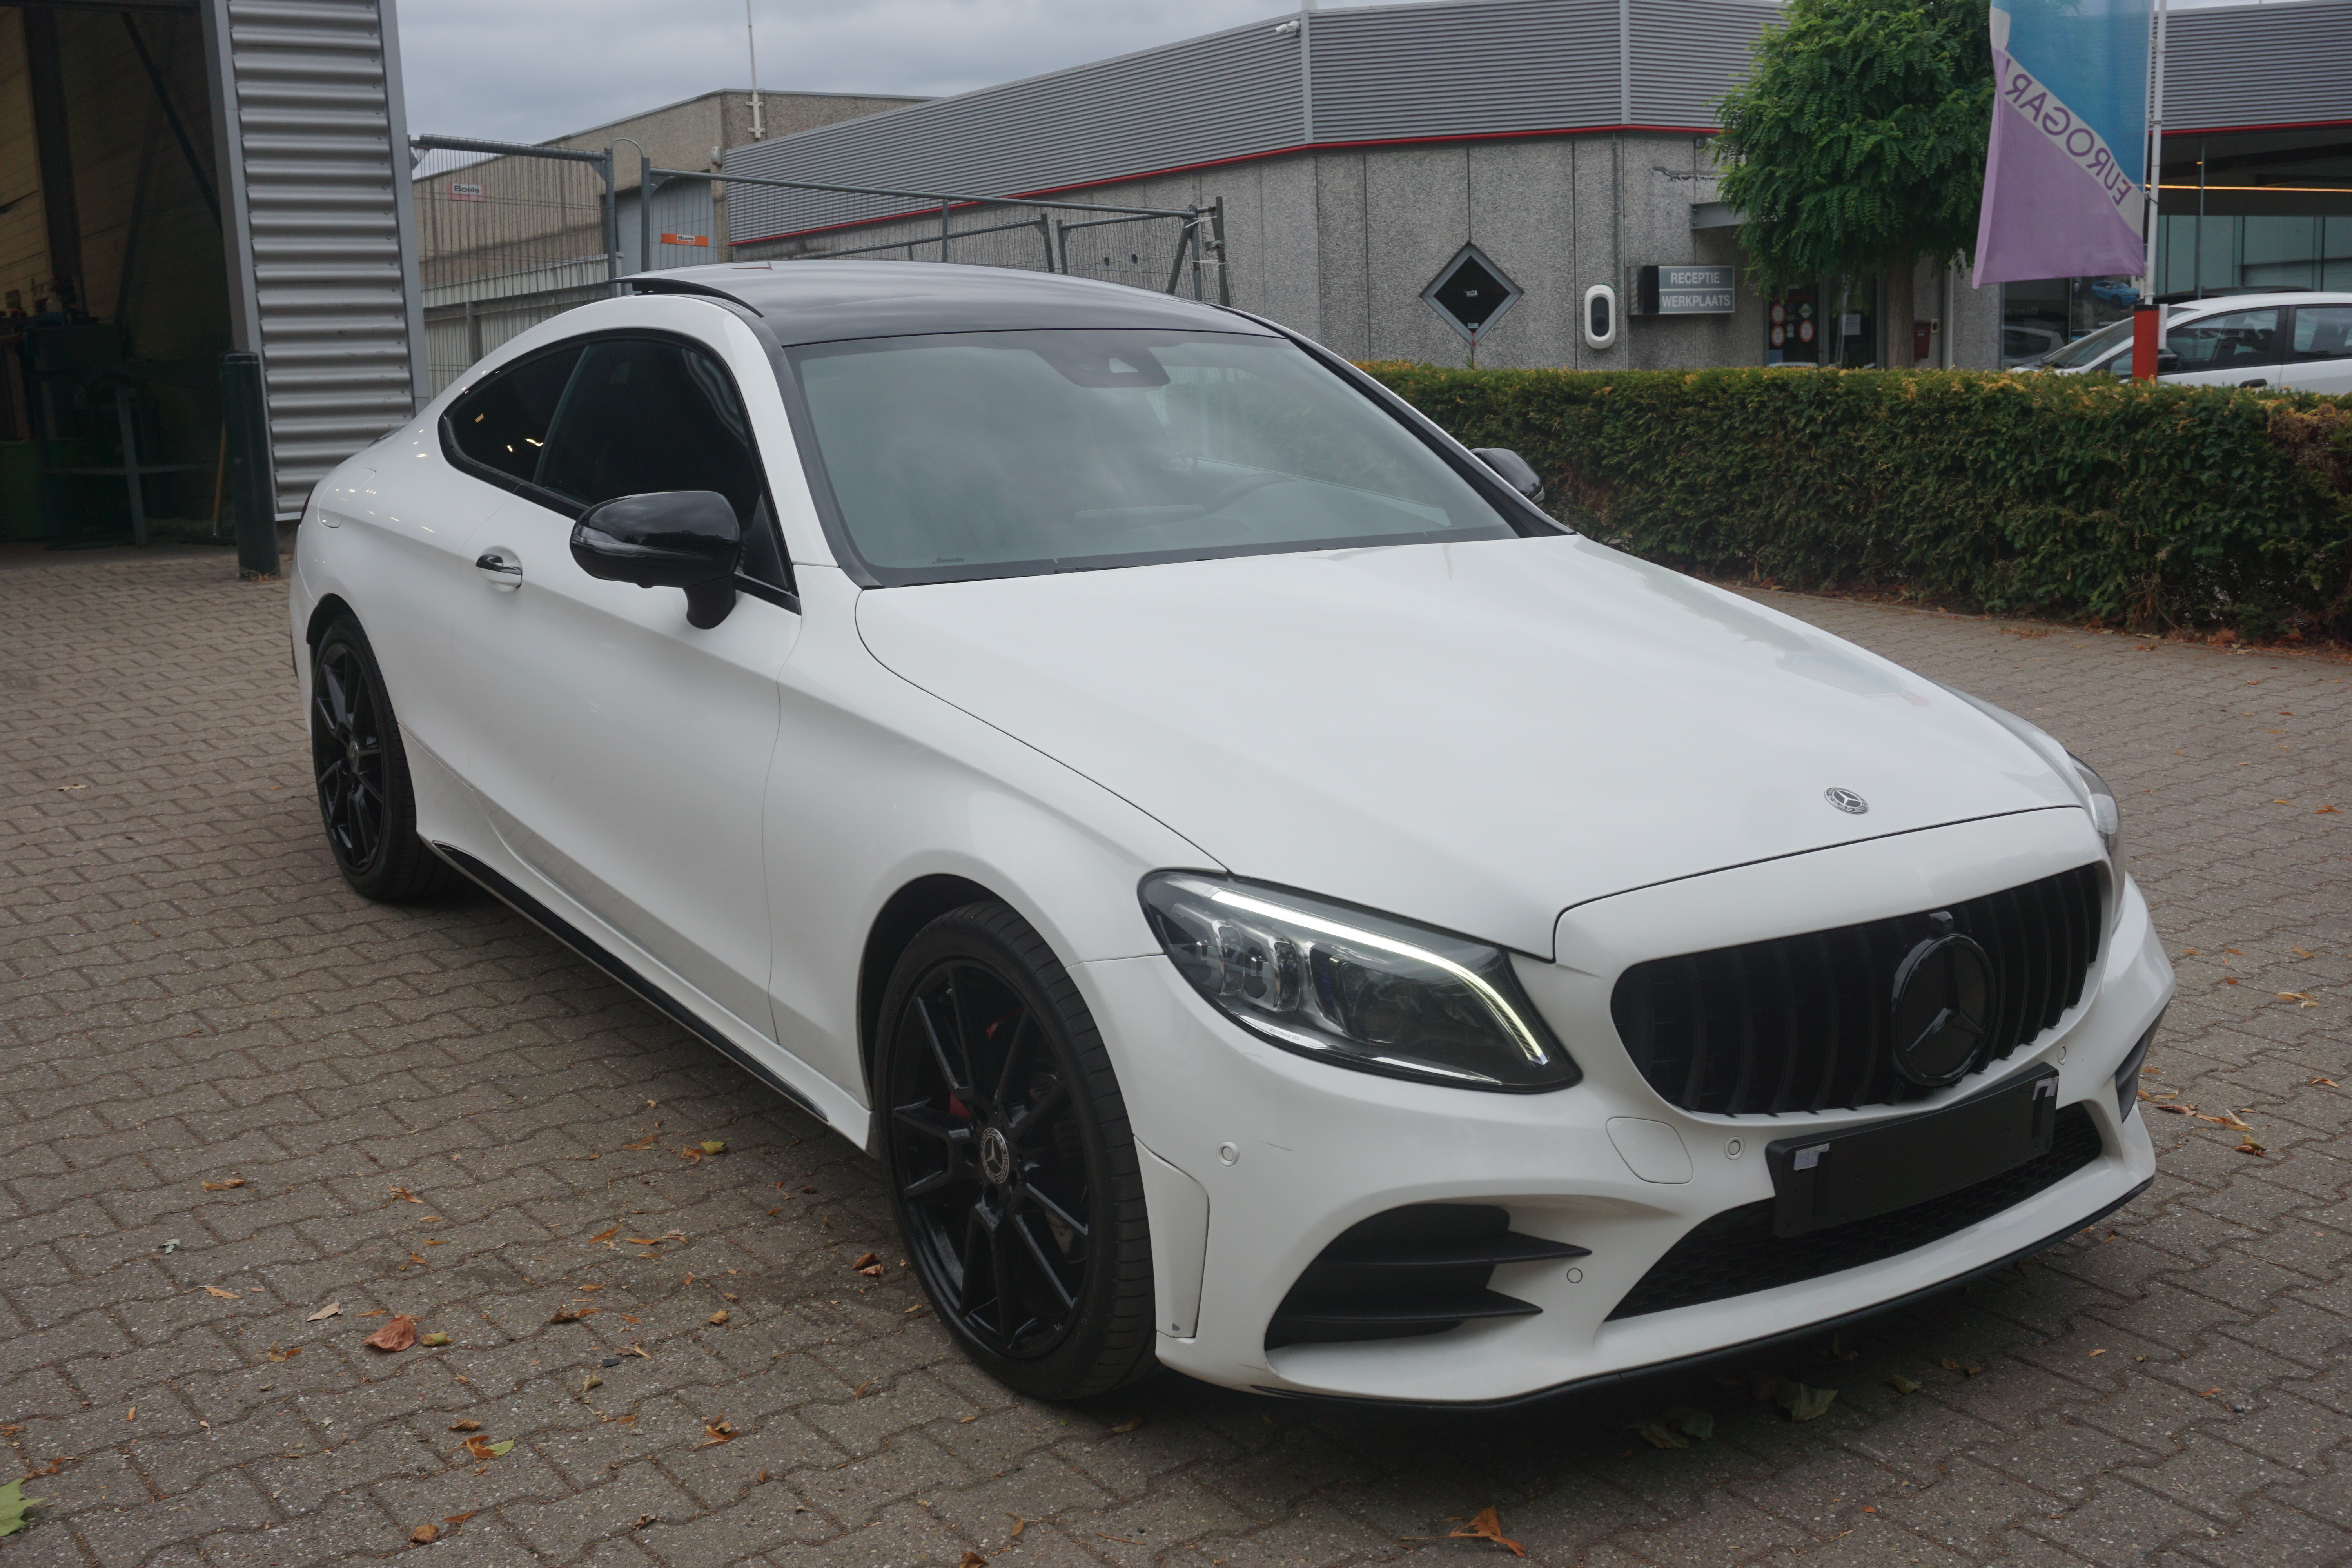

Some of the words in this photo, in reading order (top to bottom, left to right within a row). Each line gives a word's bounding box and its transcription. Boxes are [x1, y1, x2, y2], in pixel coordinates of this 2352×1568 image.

[1670, 272, 1720, 284] RECEPTIE
[1662, 295, 1730, 307] WERKPLAATS
[1270, 1028, 1291, 1038] MULTIBEAM
